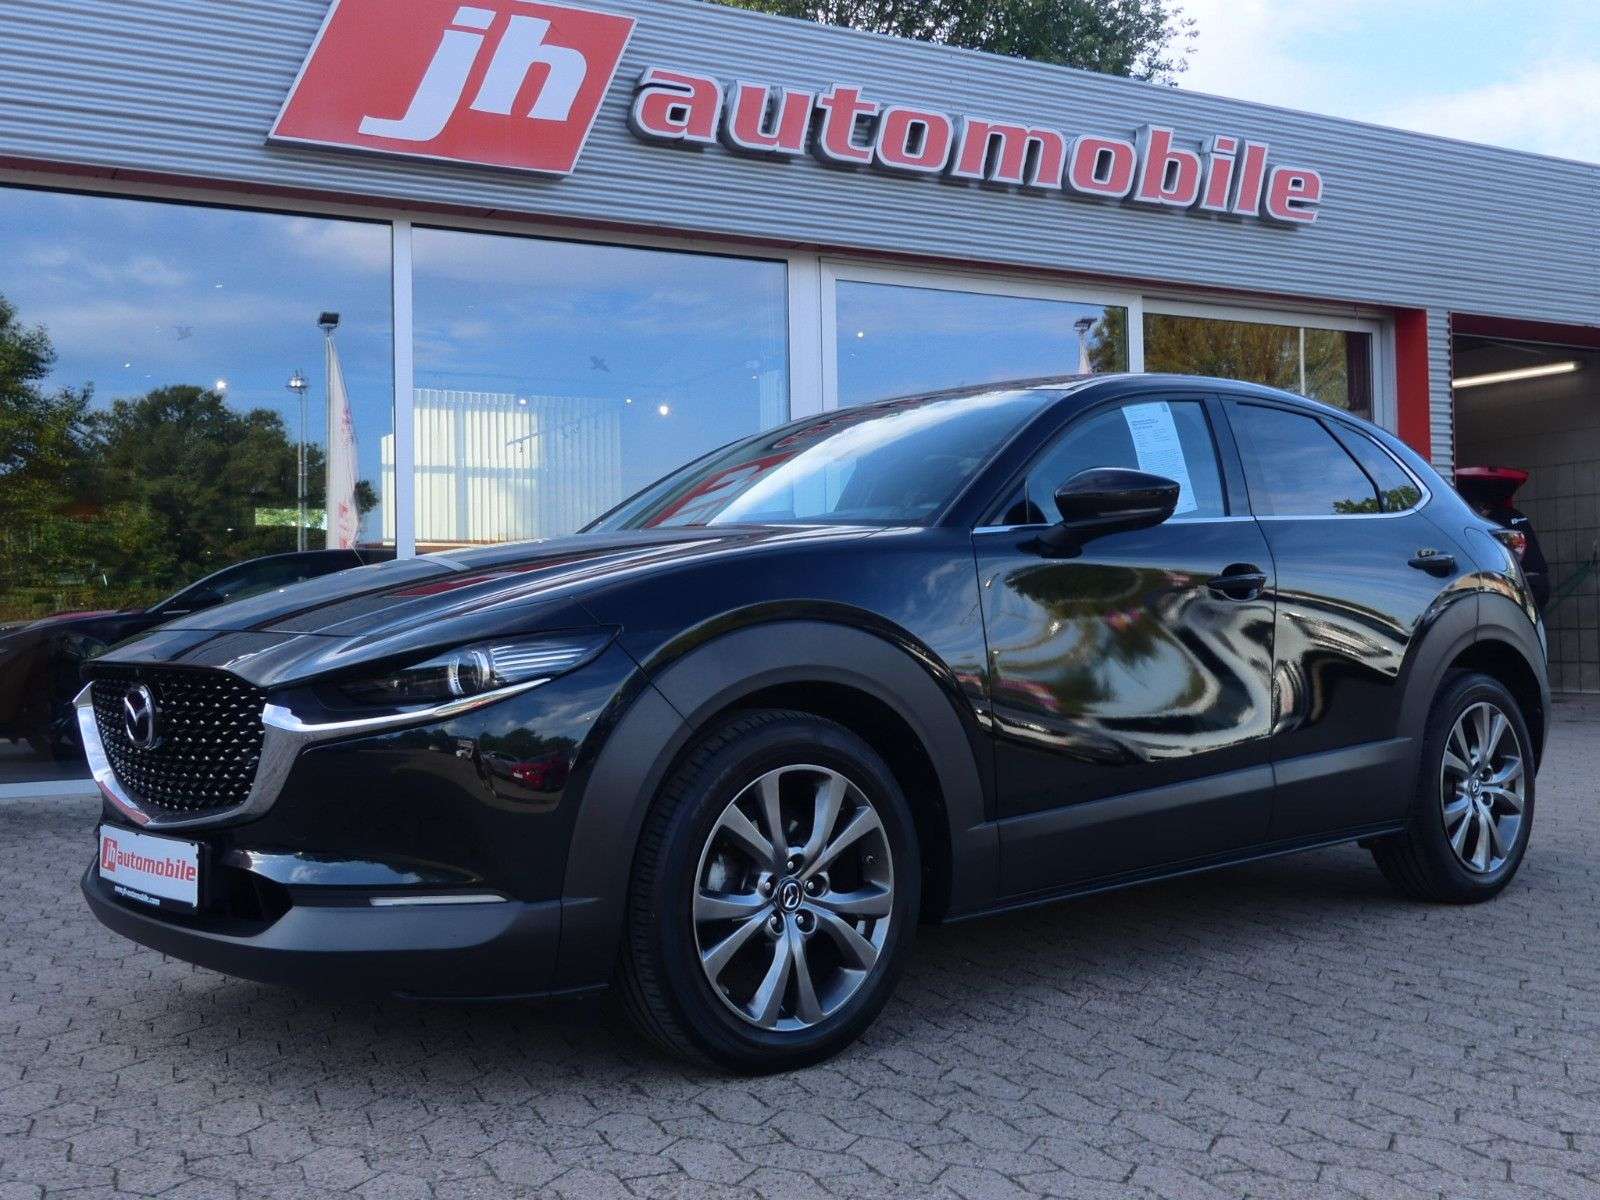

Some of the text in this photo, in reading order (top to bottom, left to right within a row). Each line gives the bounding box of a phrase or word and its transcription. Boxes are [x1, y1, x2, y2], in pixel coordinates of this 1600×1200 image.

[358, 6, 1323, 223] jh automobile
[117, 851, 196, 881] automobile
